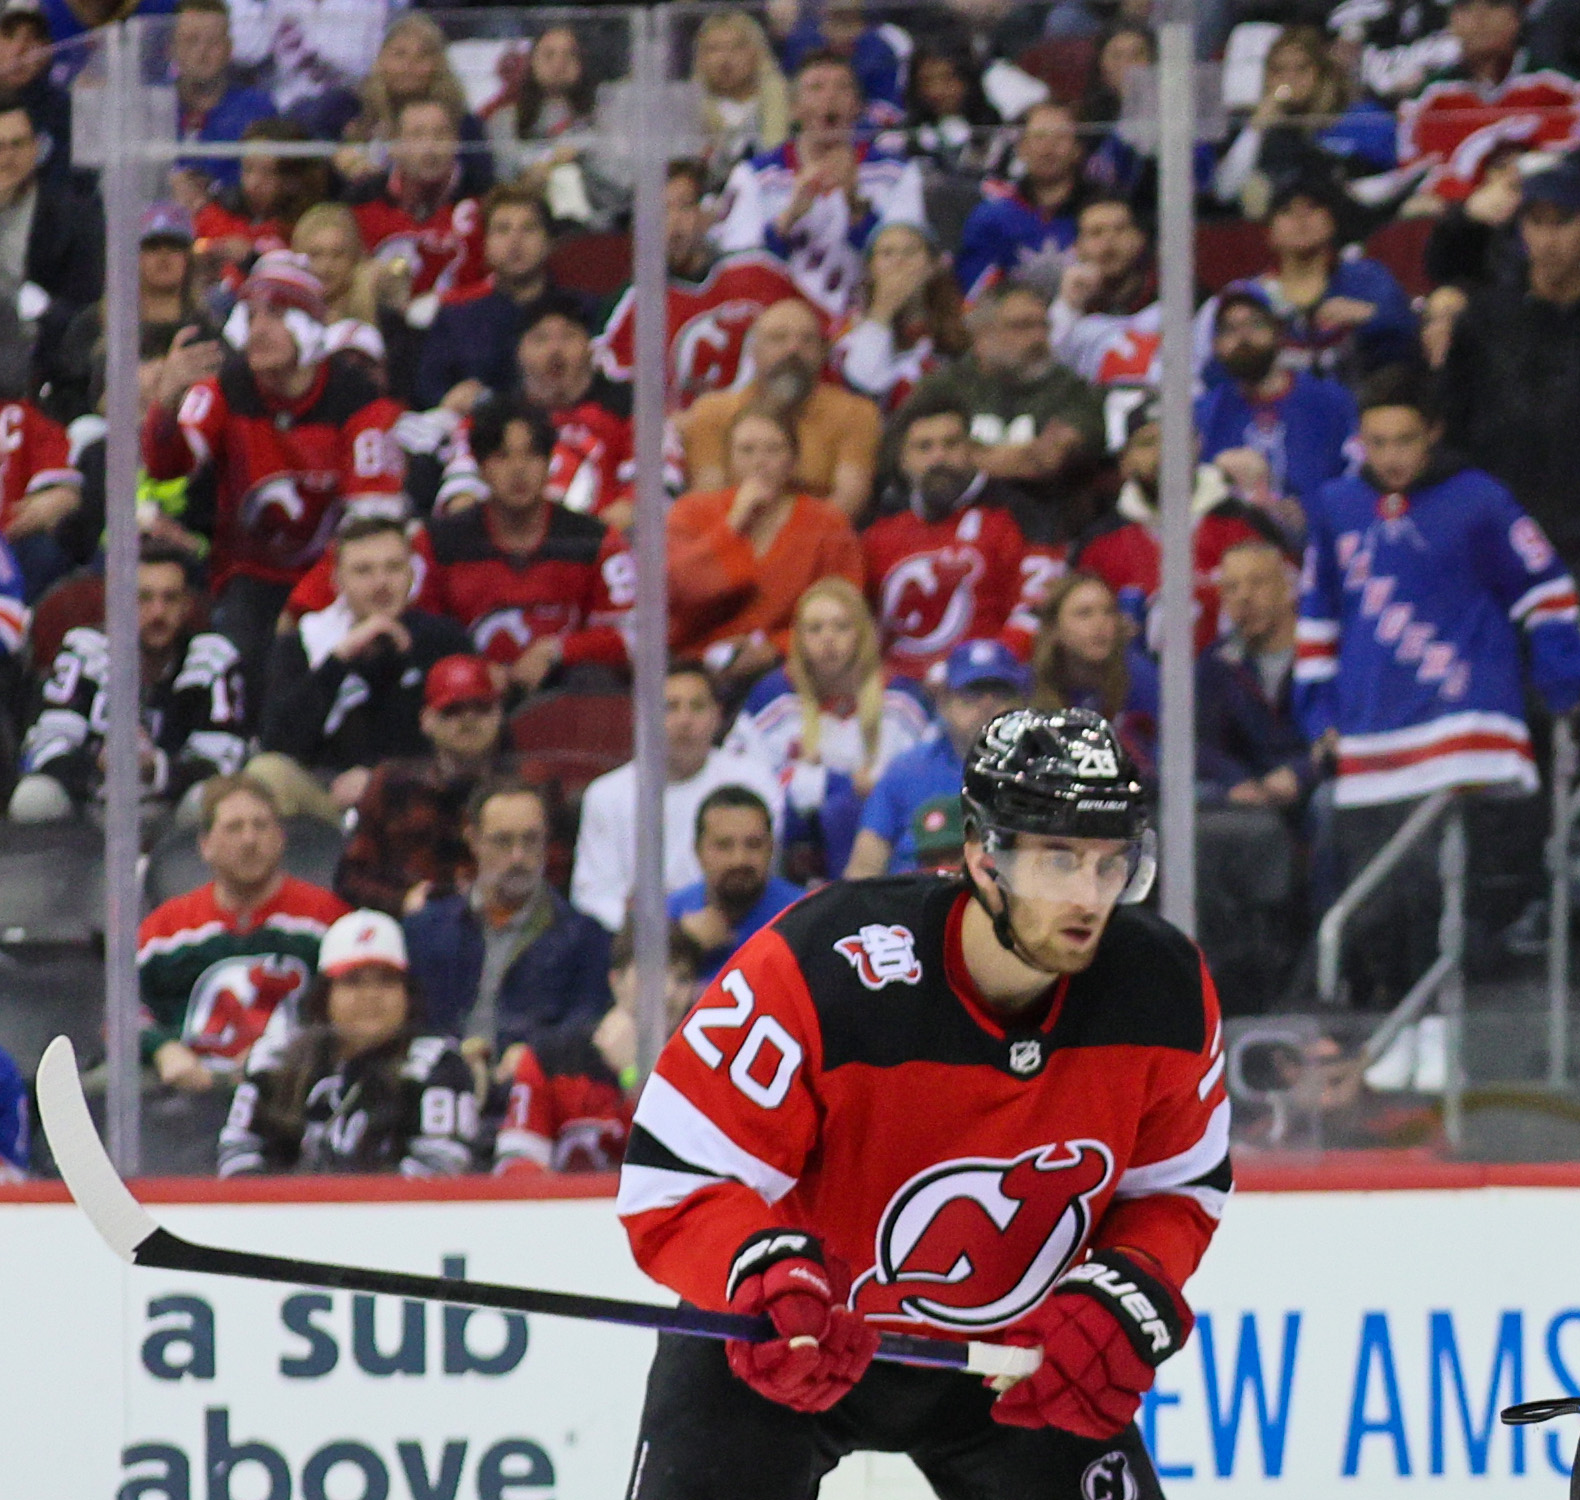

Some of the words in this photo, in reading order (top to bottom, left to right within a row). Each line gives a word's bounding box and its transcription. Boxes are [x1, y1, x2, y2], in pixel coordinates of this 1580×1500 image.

[682, 968, 803, 1110] 20
[141, 1292, 216, 1381] a
[279, 1254, 529, 1378] sub
